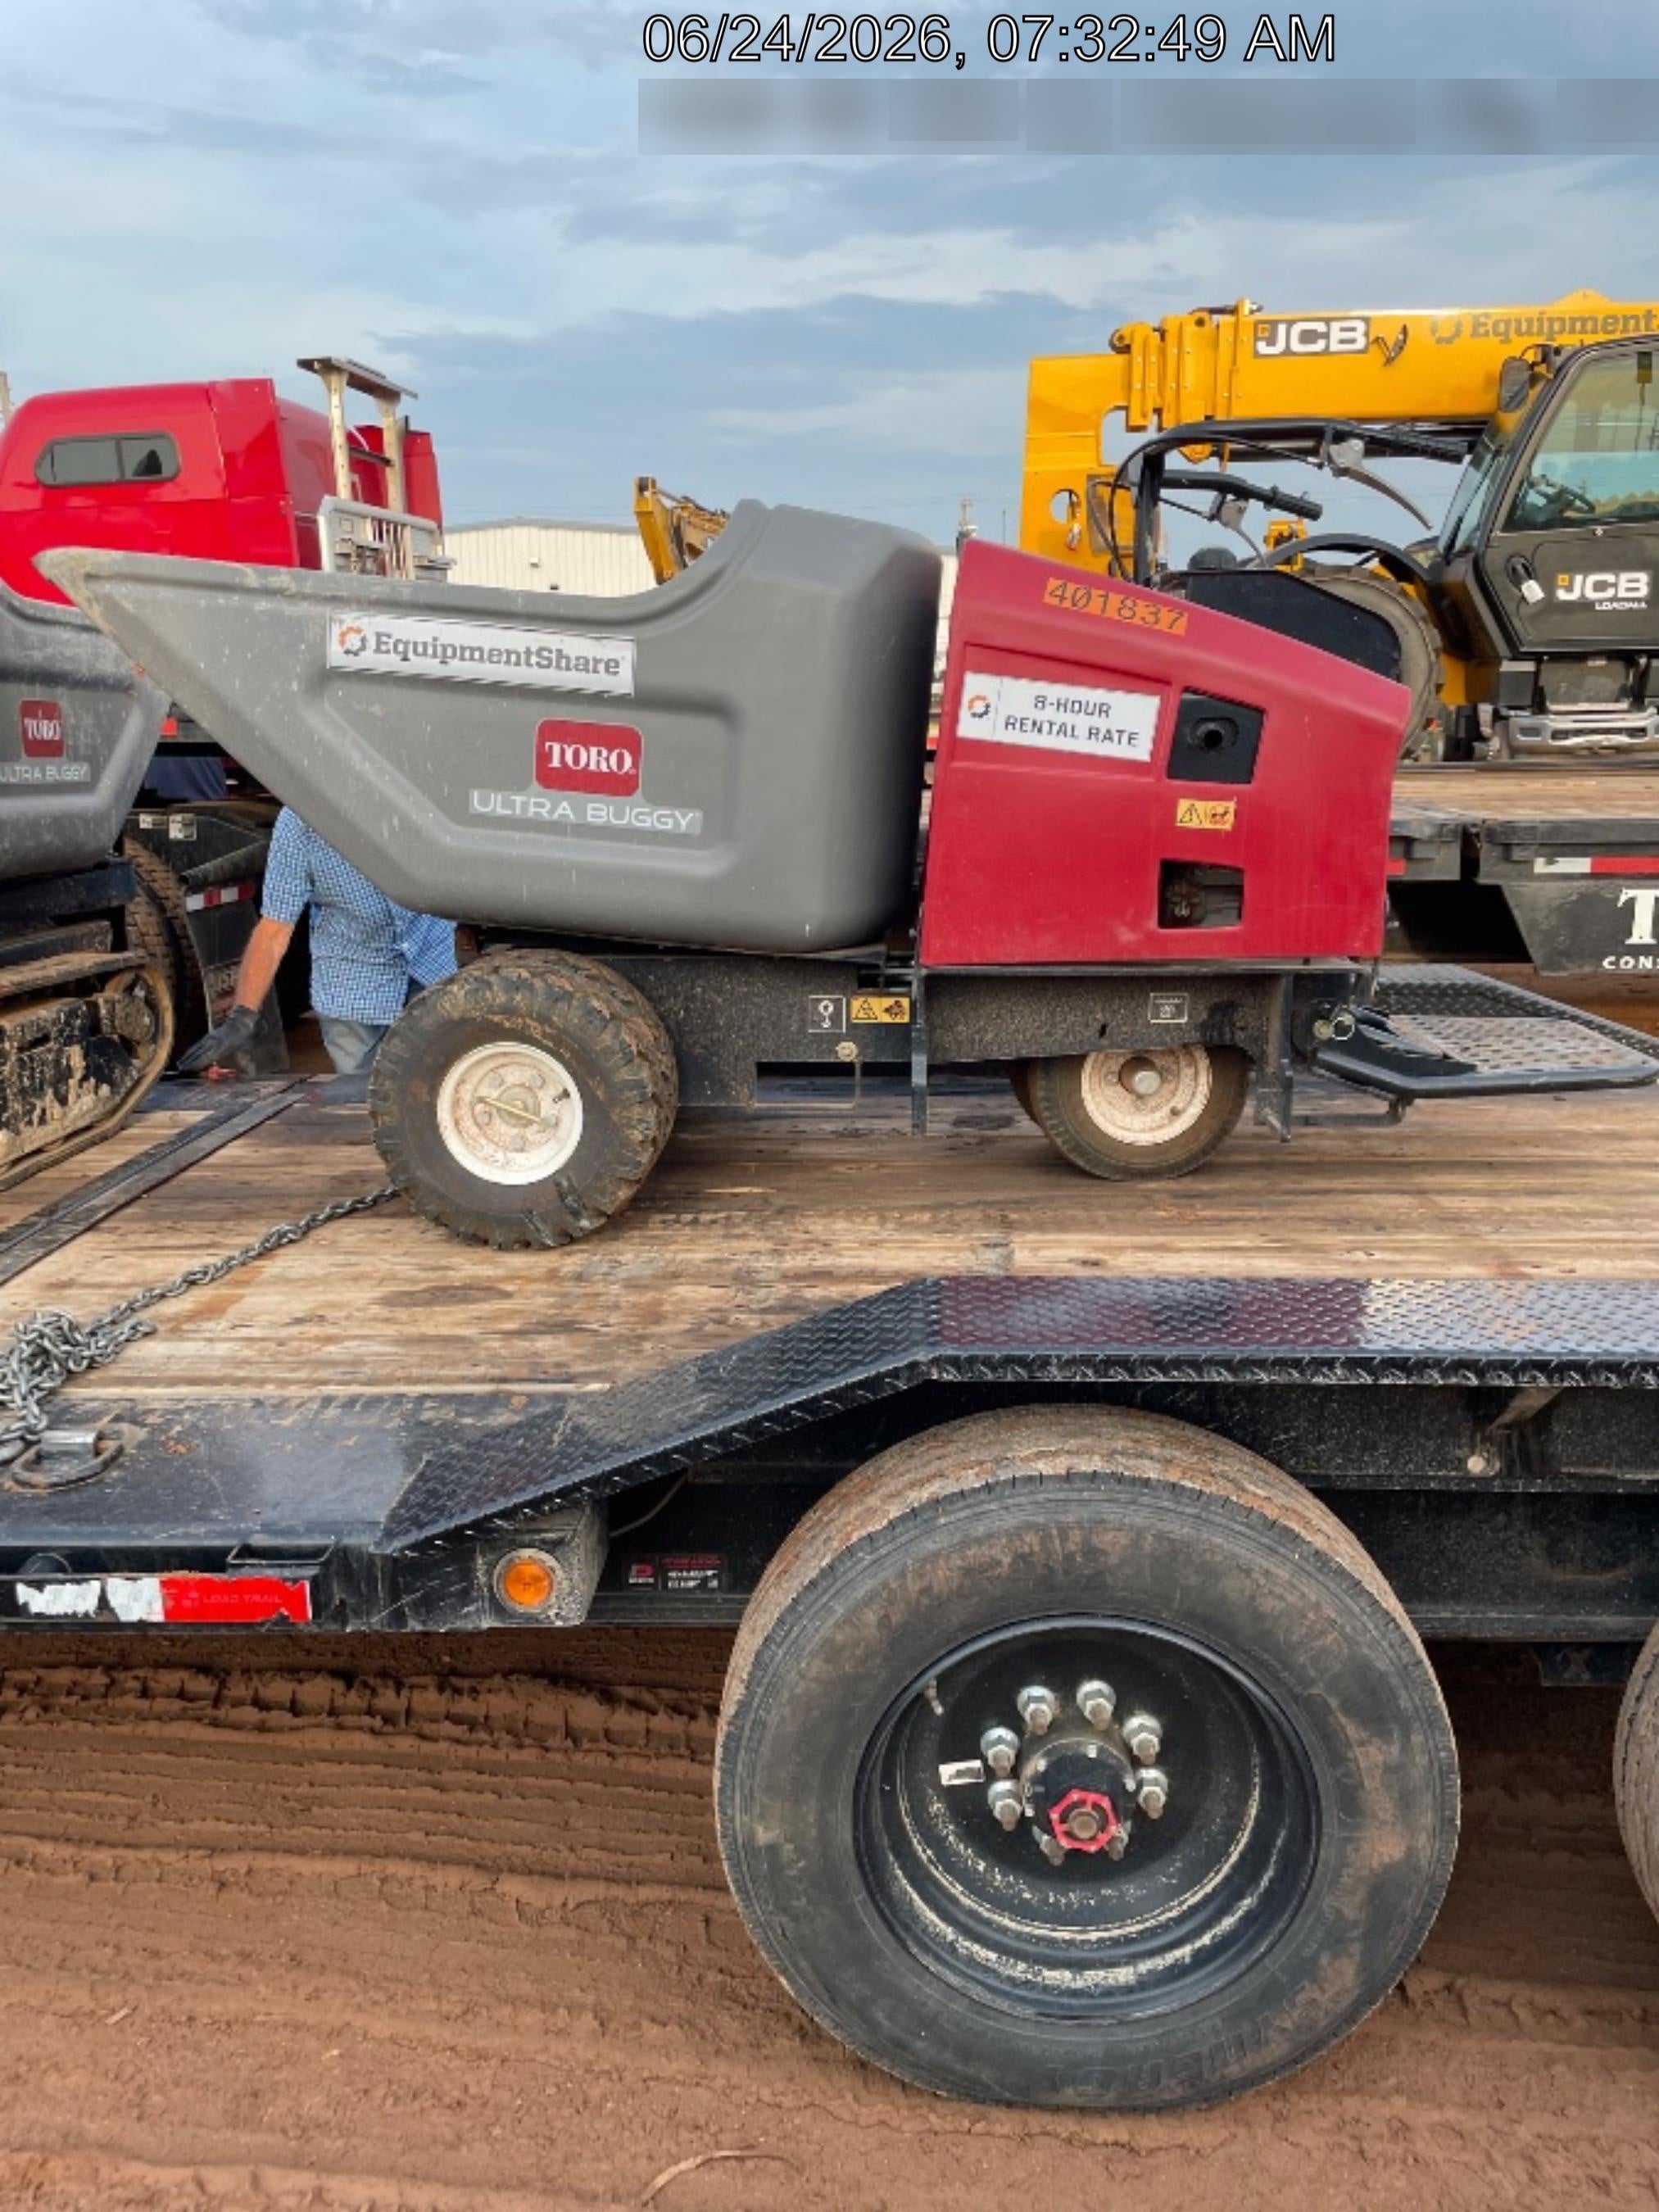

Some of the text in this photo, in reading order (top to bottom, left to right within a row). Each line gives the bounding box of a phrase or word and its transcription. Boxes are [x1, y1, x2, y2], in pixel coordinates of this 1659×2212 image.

[1256, 320, 1368, 356] JCB
[1470, 309, 1659, 345] Equipment
[1556, 572, 1649, 601] JCB
[1049, 581, 1185, 630] 401837
[373, 631, 621, 676] EquipmentShare
[1034, 695, 1112, 718] 8-HOUR
[1004, 715, 1140, 748] RENTAL RATE
[544, 741, 634, 774] TORO
[472, 791, 695, 831] ULTRA BUGGY
